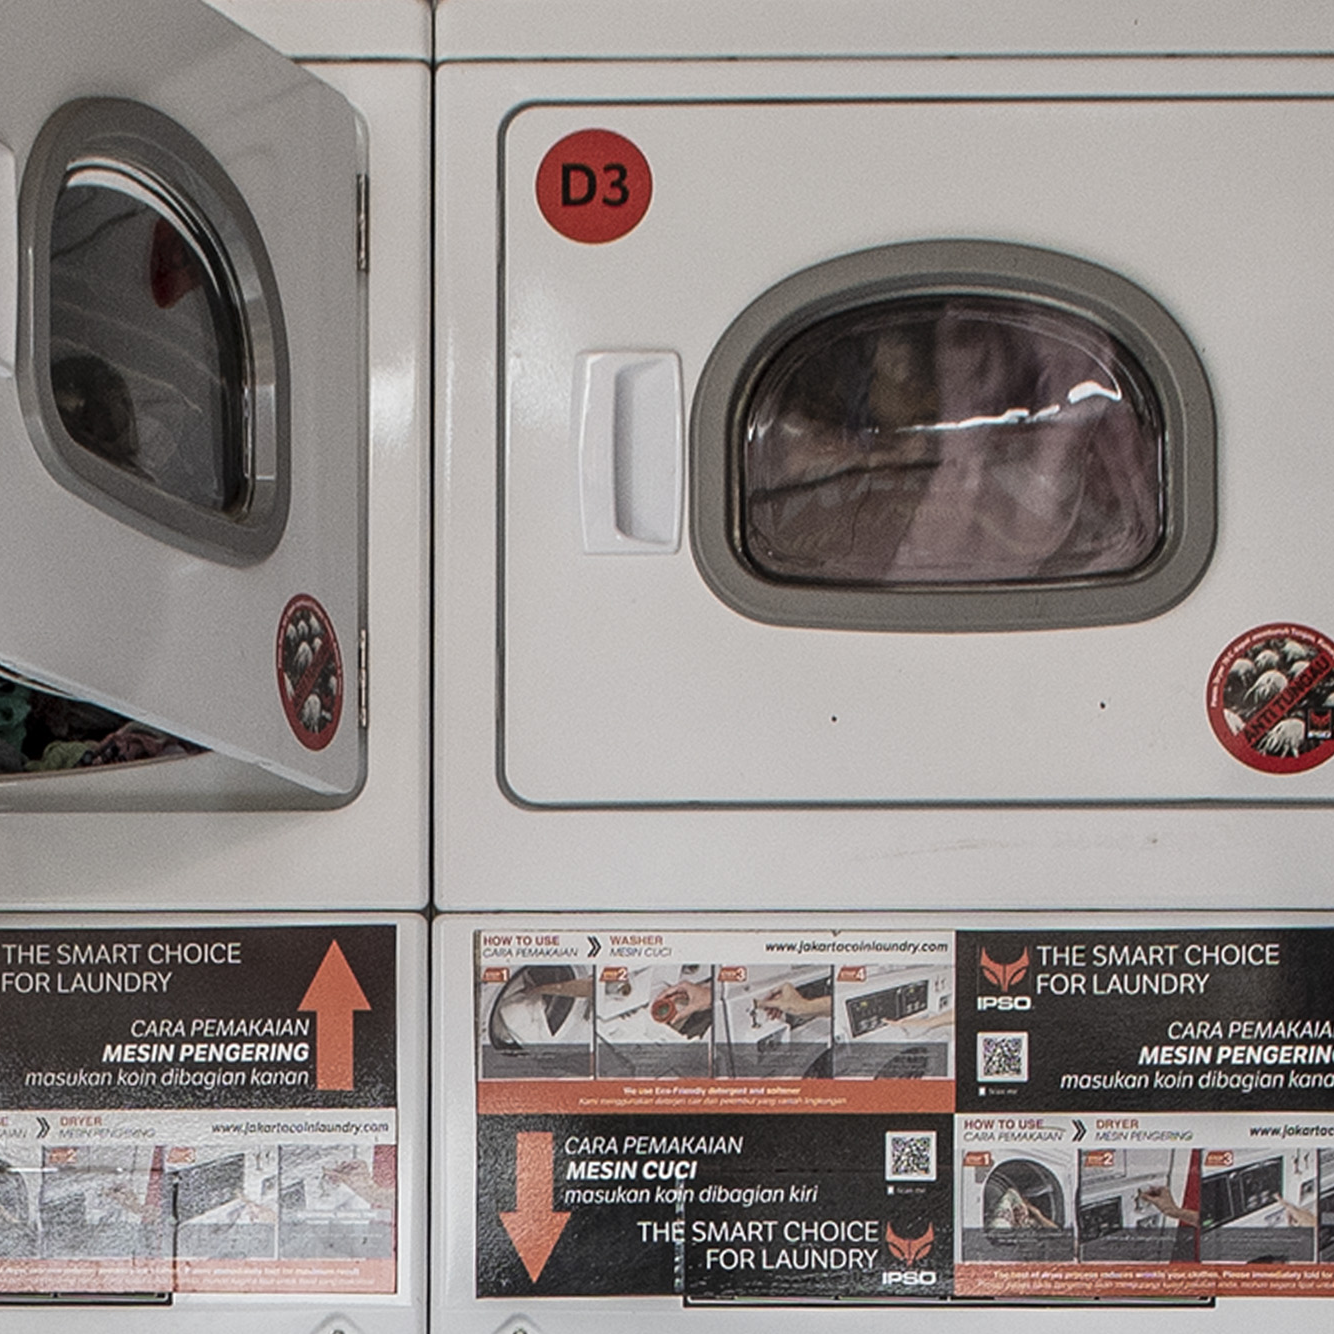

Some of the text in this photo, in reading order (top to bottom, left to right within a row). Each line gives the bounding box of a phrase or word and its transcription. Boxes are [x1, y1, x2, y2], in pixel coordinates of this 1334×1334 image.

[560, 163, 631, 208] D3
[481, 934, 560, 949] HOW TO USE
[609, 935, 664, 949] WASHER
[1, 942, 242, 965] THE SMART CHOICE
[1036, 943, 1280, 967] THE SMART CHOICE
[1, 971, 173, 994] FOR LAUNDRY
[1036, 972, 1210, 995] FOR LAUNDRY
[977, 995, 1032, 1011] IPSO
[130, 1018, 310, 1038] CARA PEMAKAIAN
[1167, 1020, 1224, 1040] CARA
[101, 1042, 310, 1063] MESIN PENGERING
[1138, 1045, 1213, 1065] MESIN
[24, 1068, 309, 1092] masukan koin dibagian kanan
[1060, 1070, 1150, 1090] masukan
[1153, 1070, 1194, 1089] koin
[1197, 1070, 1285, 1093] dibagian
[963, 1118, 1045, 1133] HOW TO USE
[1095, 1118, 1139, 1133] DRYER
[563, 1135, 744, 1156] CARA PEMAKAIAN
[564, 1160, 698, 1183] MESIN CUCI
[562, 1183, 819, 1207] masukan koin dibagian kiri
[636, 1219, 879, 1245] THE SMART CHOICE
[706, 1248, 879, 1274] FOR LAUNDRY
[881, 1271, 937, 1289] IPSO
